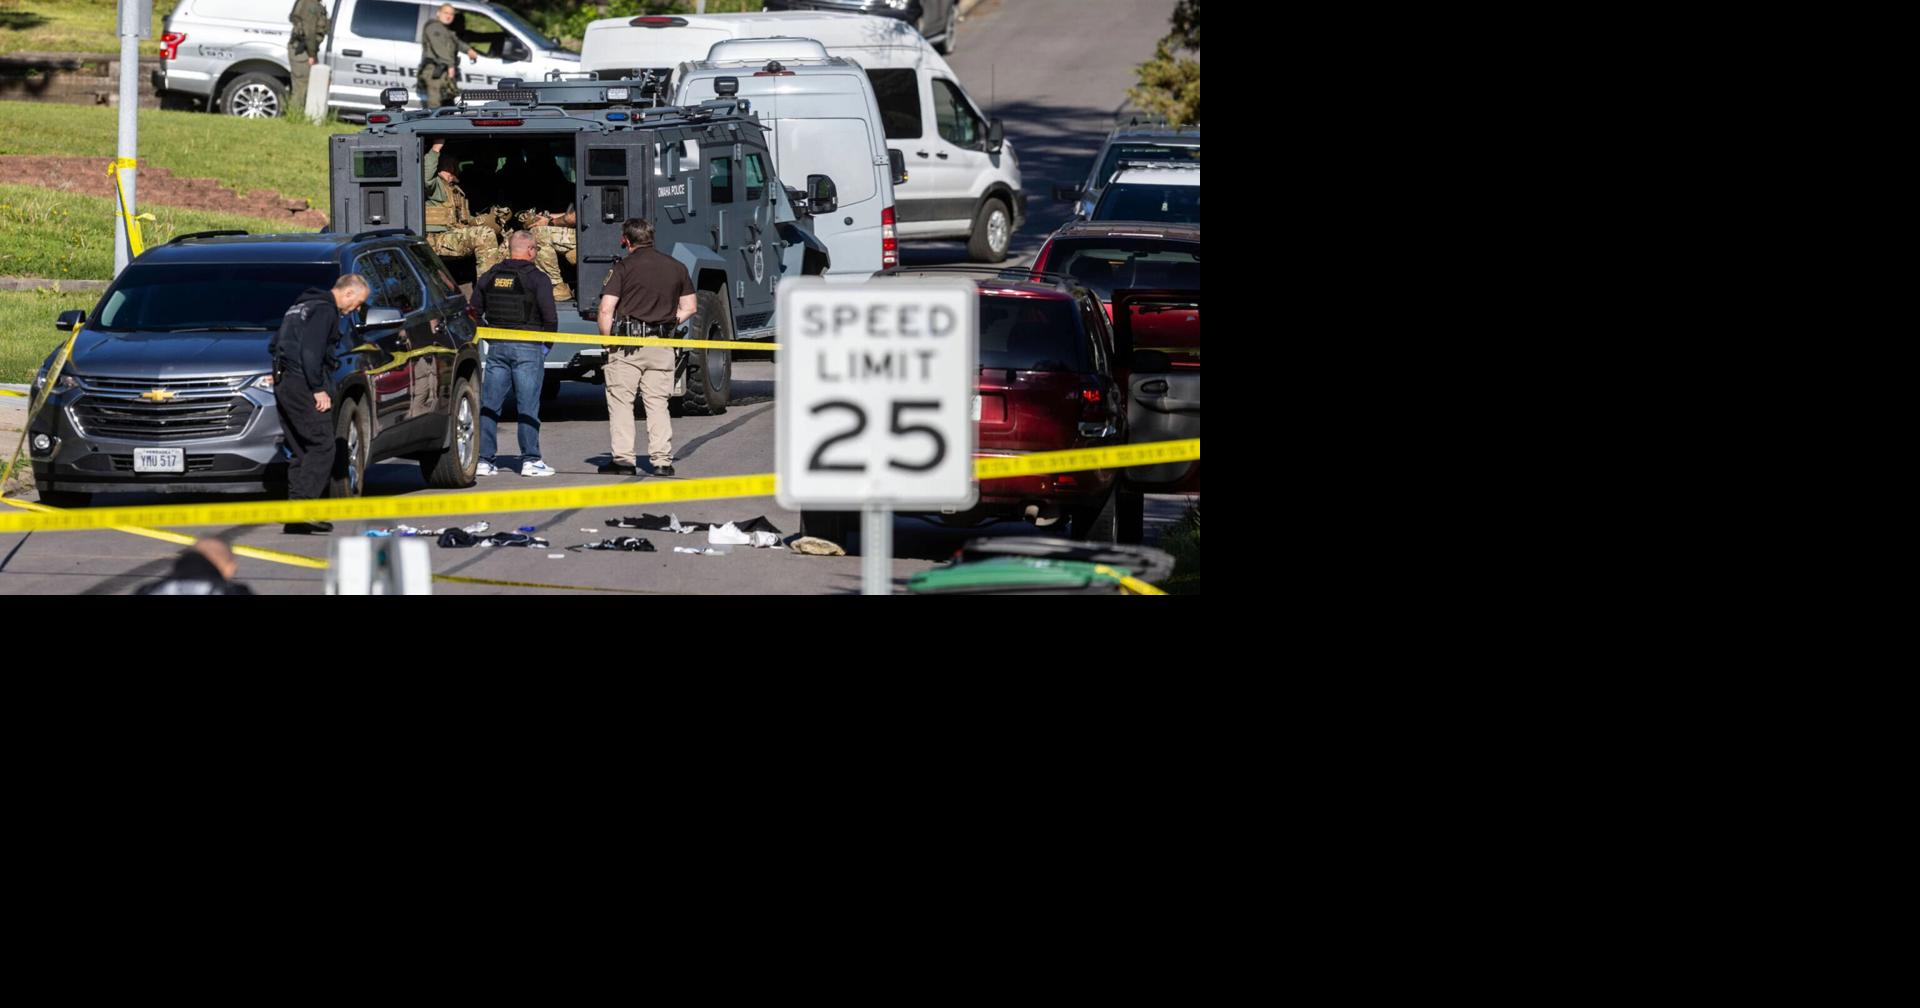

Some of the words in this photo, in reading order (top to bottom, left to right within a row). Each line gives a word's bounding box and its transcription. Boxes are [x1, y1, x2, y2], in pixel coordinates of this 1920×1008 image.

[657, 187, 671, 198] OMAHA
[671, 184, 685, 196] POLICE
[802, 303, 957, 338] SPEED
[816, 350, 936, 383] LIMIT
[808, 399, 947, 475] 25
[160, 455, 177, 467] 517
